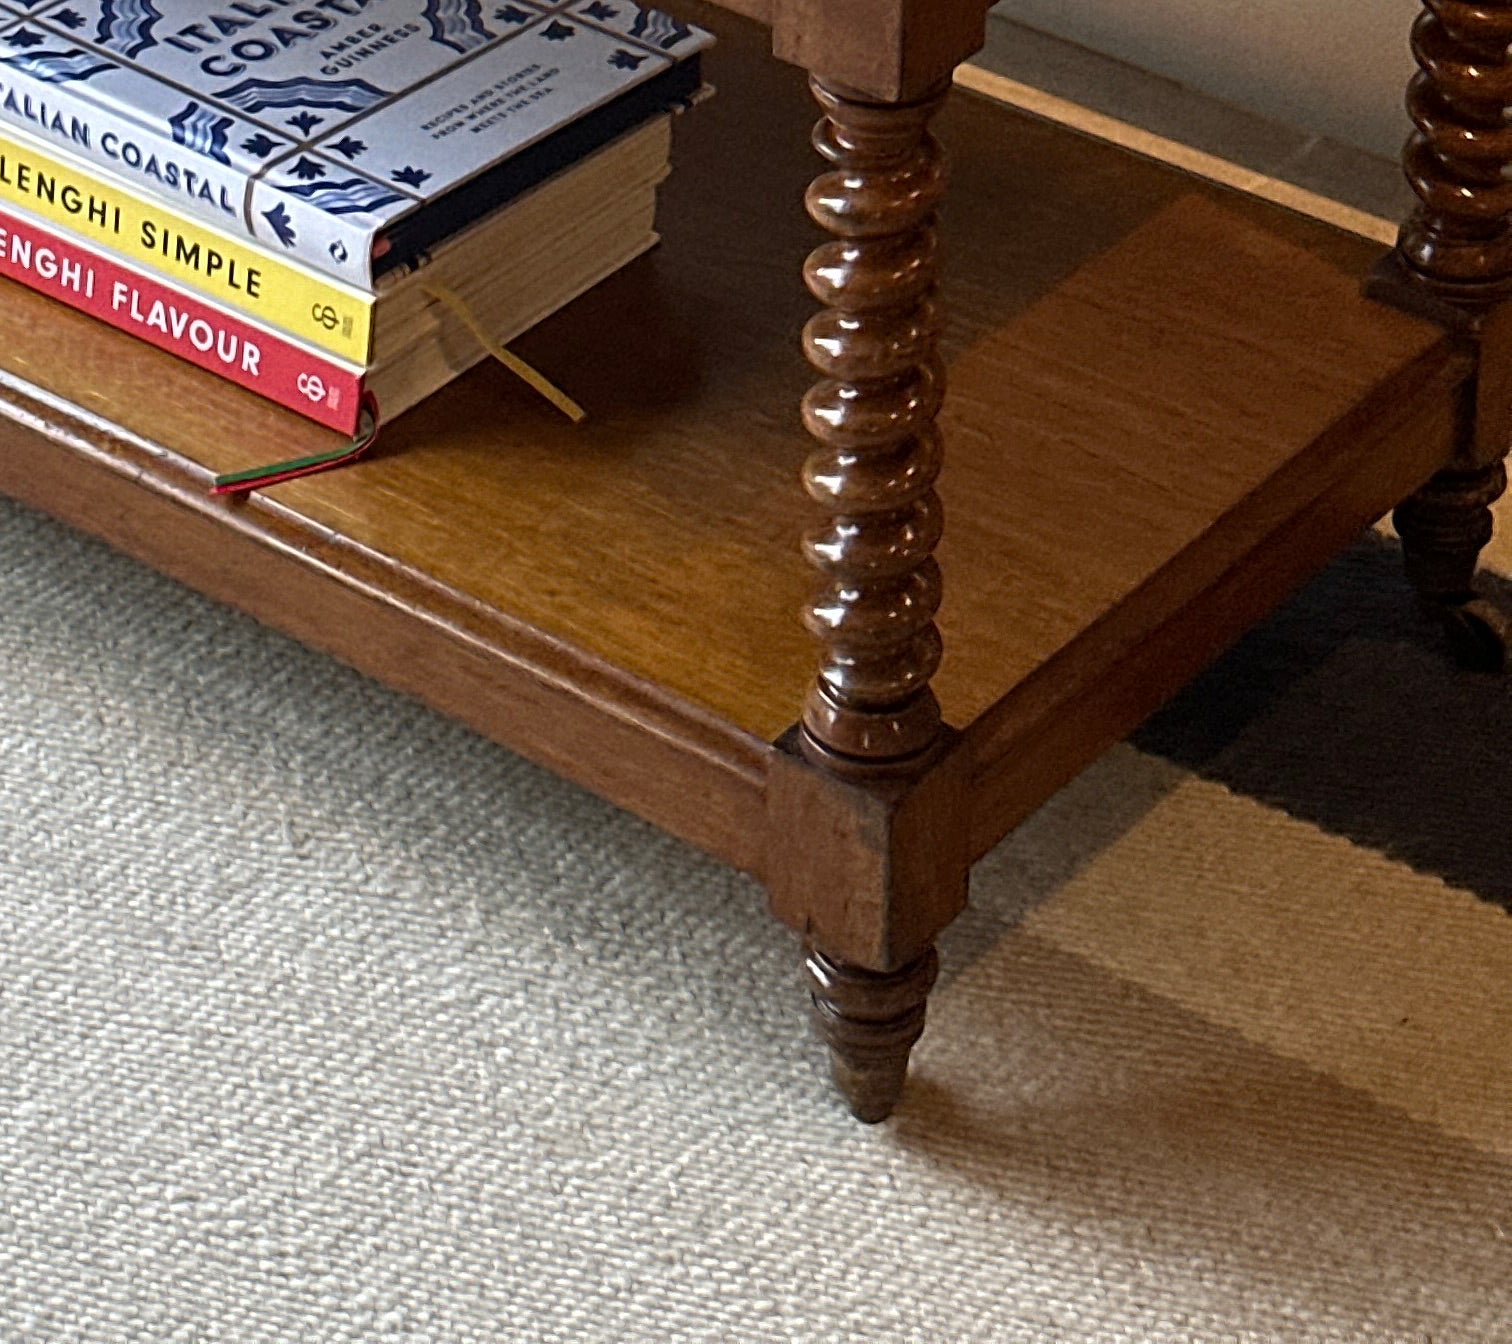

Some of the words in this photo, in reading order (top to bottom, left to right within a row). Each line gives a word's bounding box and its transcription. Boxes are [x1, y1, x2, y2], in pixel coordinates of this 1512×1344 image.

[320, 23, 385, 60] AMBER
[320, 22, 422, 76] GUINNESS
[100, 131, 236, 217] COASTAL
[141, 220, 263, 299] SIMPLE
[111, 280, 262, 377] FLAVOUR
